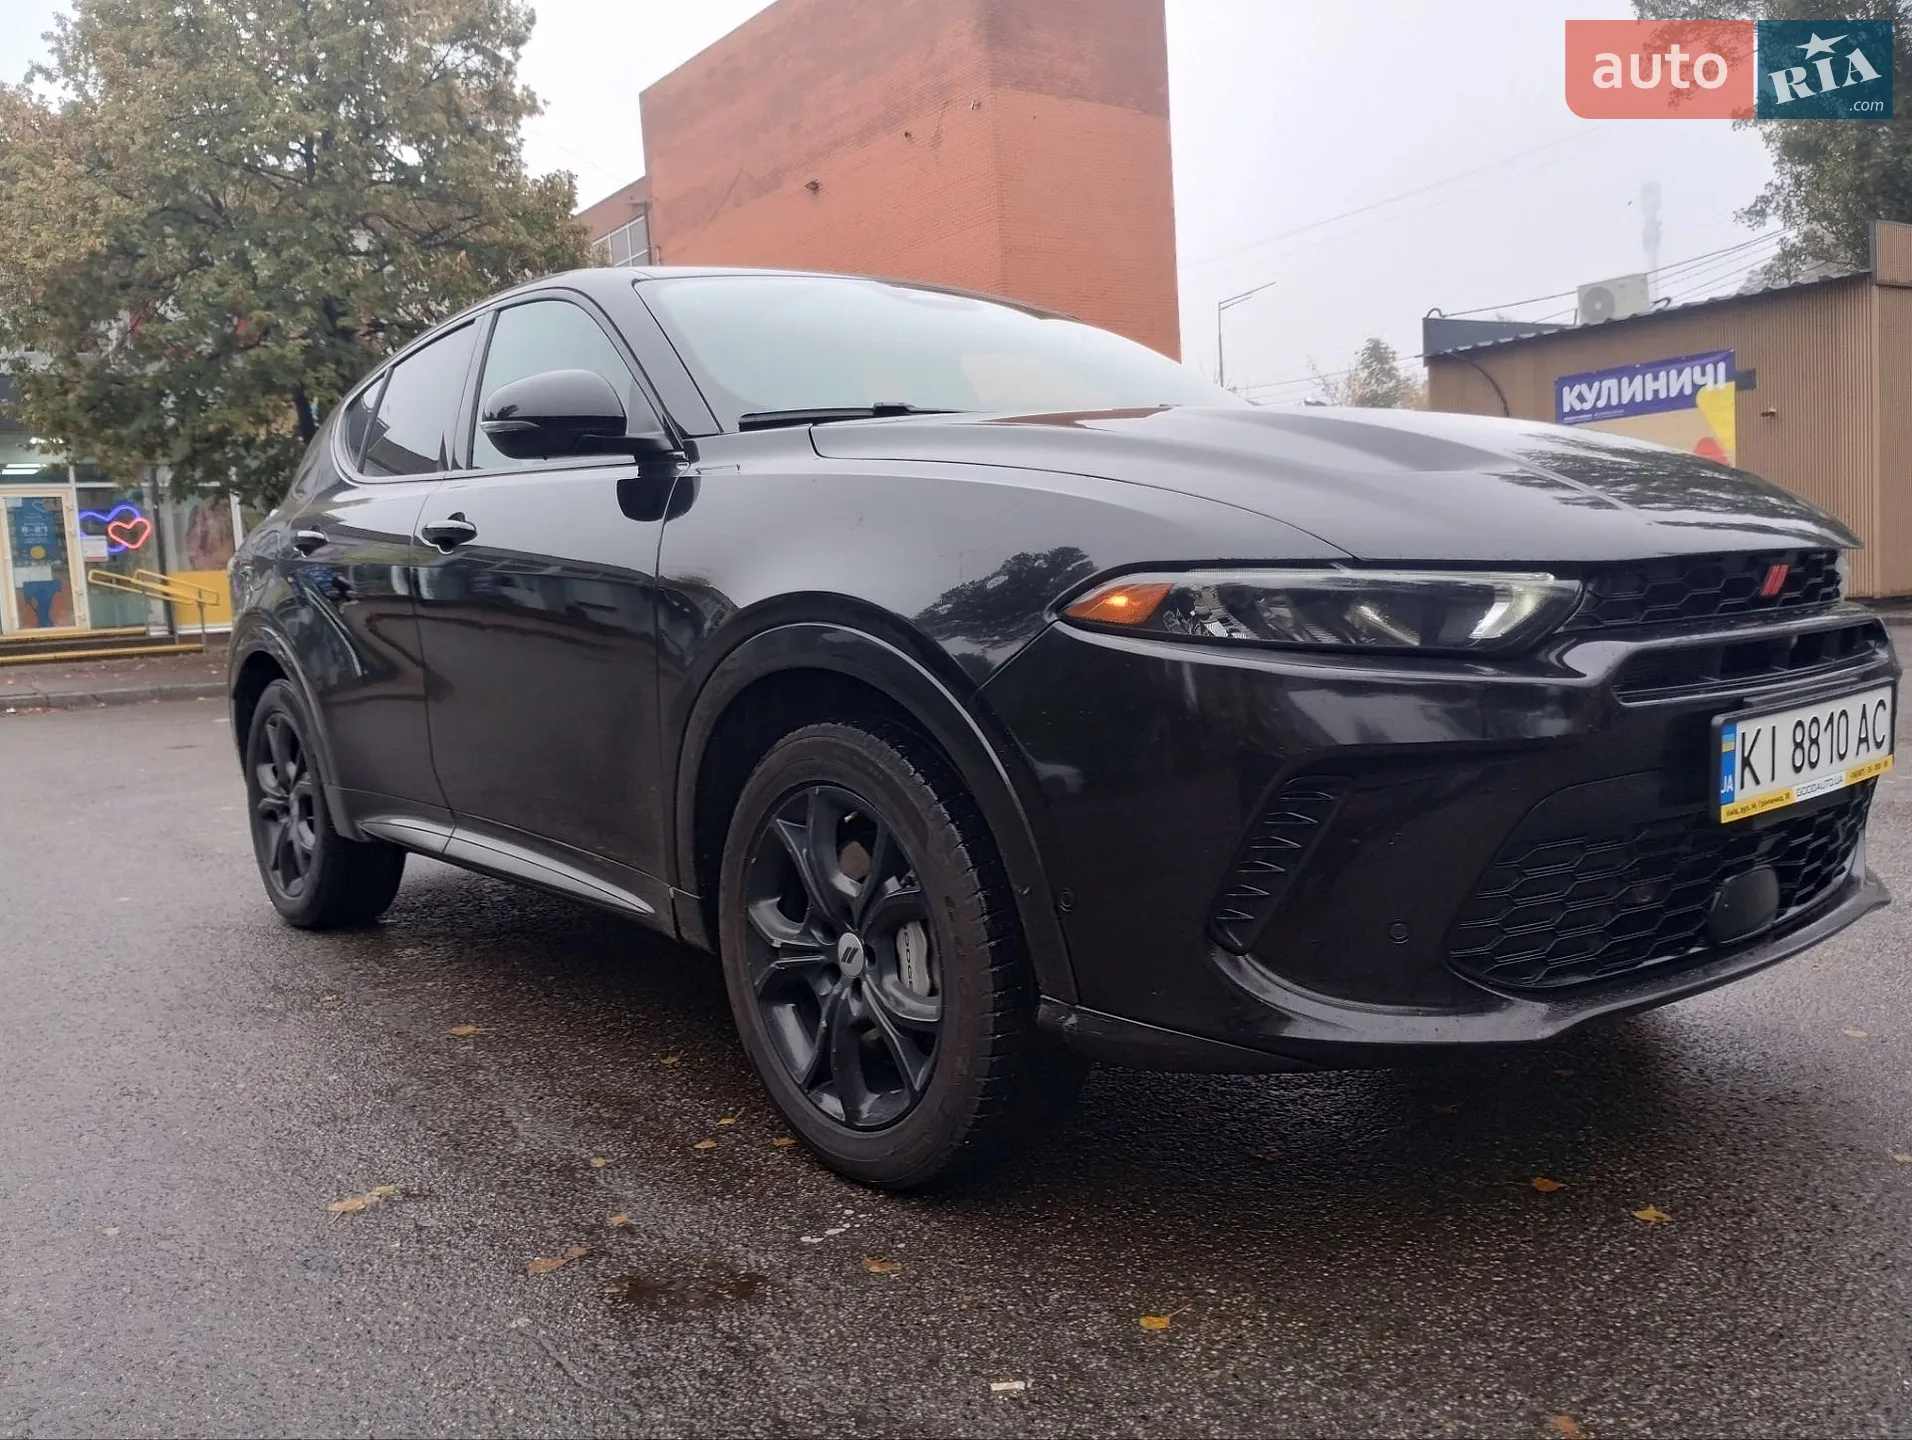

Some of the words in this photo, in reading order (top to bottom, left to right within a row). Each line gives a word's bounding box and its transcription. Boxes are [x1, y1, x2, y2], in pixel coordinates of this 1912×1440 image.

[1563, 361, 1726, 412] КУЛИНИЧІ
[1740, 725, 1776, 790] KI
[1791, 709, 1848, 774] 8810
[1856, 699, 1887, 756] AC
